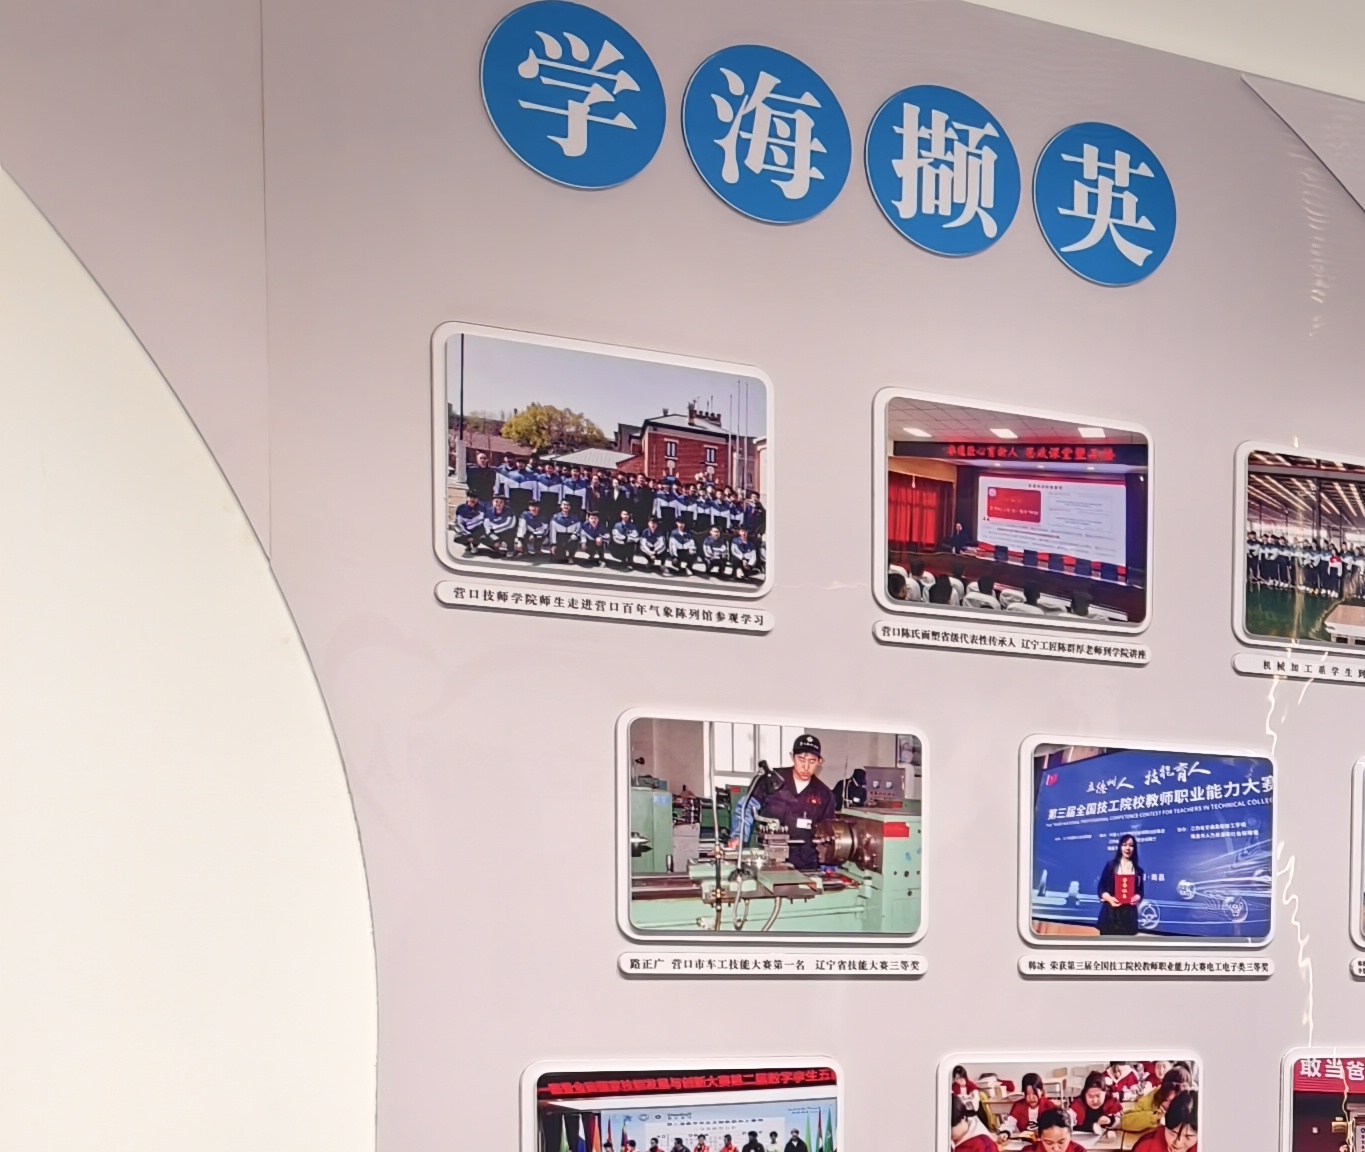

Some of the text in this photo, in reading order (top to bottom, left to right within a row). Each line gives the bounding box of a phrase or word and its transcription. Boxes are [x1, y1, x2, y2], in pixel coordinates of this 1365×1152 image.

[517, 28, 1157, 268] 学海撷英
[453, 586, 765, 627] 营口技师学院师生走进营口百年气象陈列馆参观学习
[881, 625, 1016, 649] 营口陈氏面塑省级代表性传承人
[1047, 777, 1275, 821] 第三届全国技工院校教师职业能力大赛
[671, 958, 806, 971] 营口市车工技能大赛第一名
[814, 959, 920, 972] 辽宁省技能大赛三等奖
[1049, 960, 1269, 973] 荣获第三届全国技工院校教师职业能力大赛电工电子类三等奖
